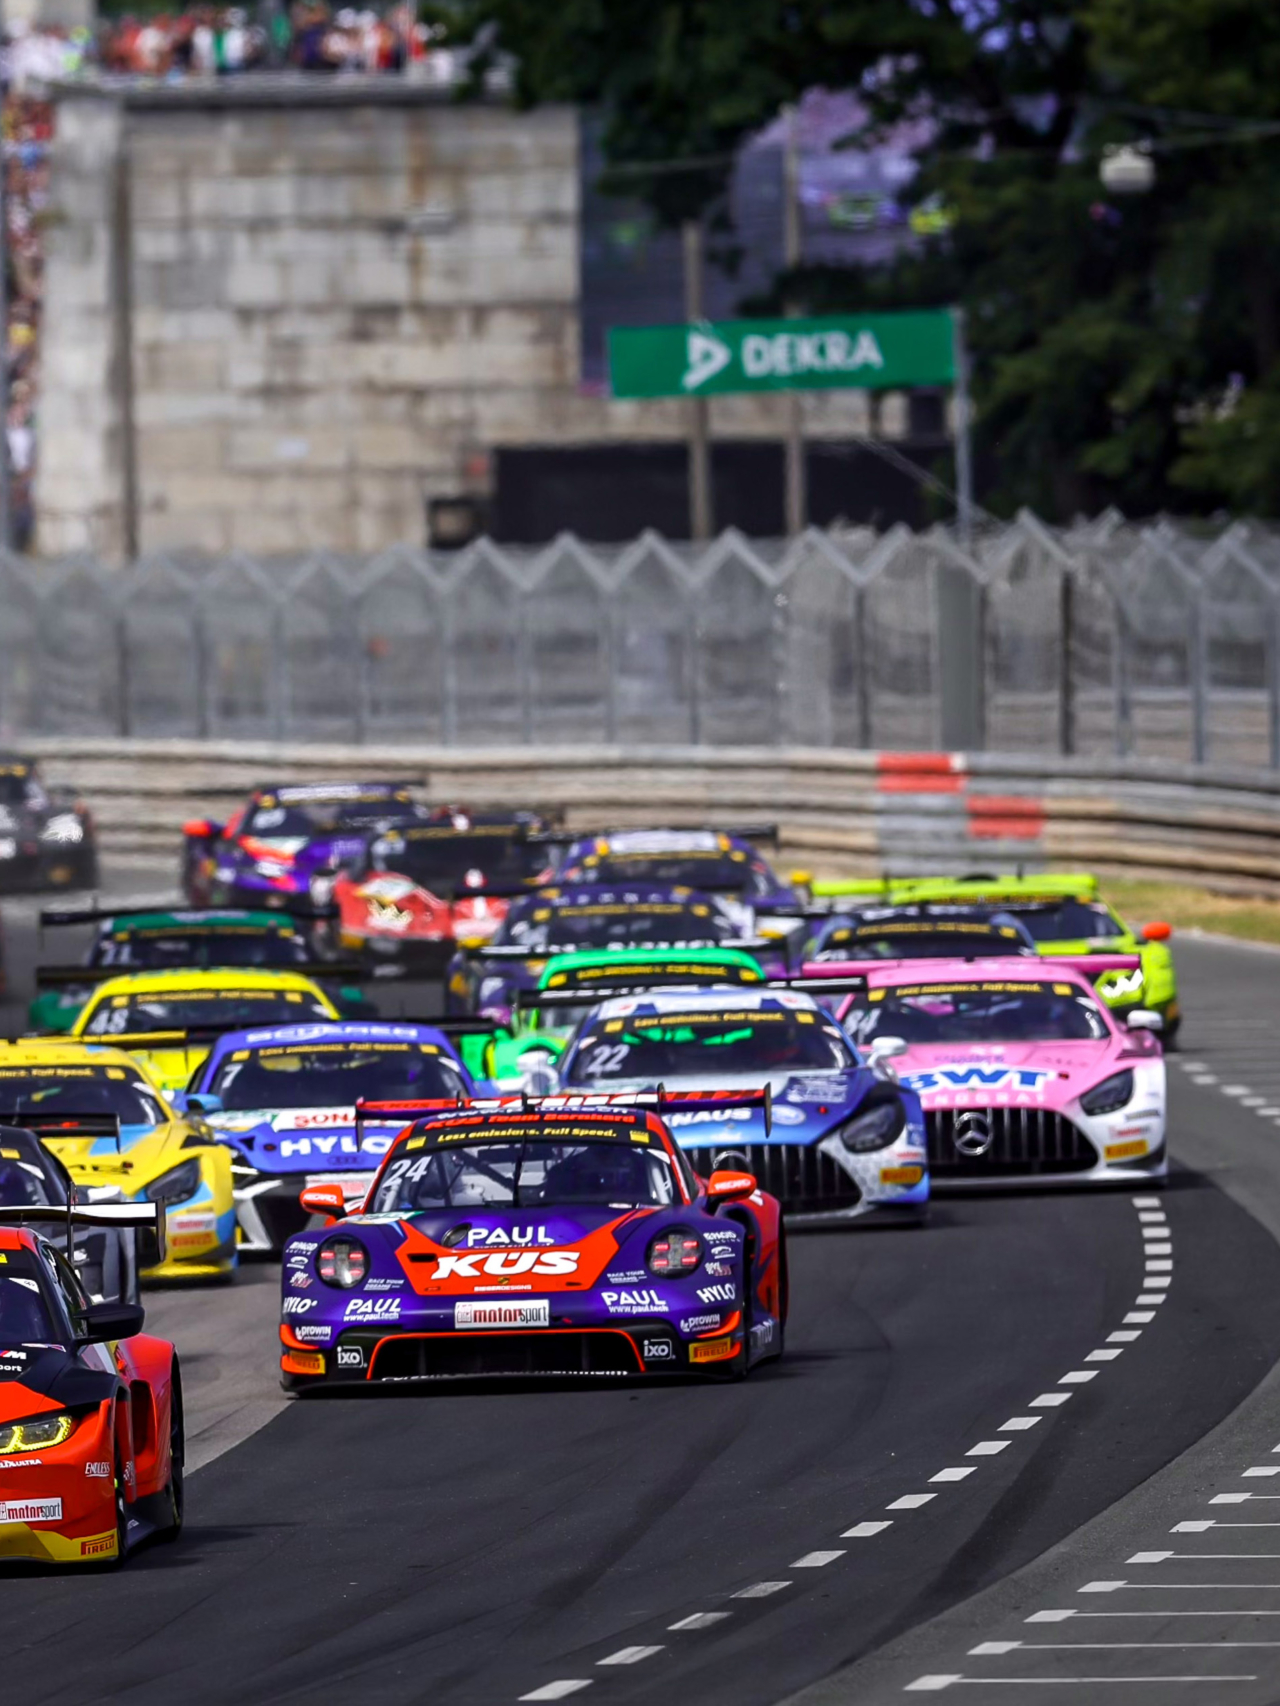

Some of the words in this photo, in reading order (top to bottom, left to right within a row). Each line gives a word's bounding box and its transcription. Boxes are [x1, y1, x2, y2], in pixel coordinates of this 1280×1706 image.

[741, 330, 885, 378] DEKRA
[587, 1044, 630, 1074] 22
[221, 1064, 243, 1088] 7
[543, 1113, 636, 1124] Bernhard
[437, 1131, 466, 1143] Less
[468, 1128, 539, 1139] emissions.
[542, 1127, 570, 1137] Full
[572, 1127, 617, 1138] Speed.
[280, 1135, 395, 1158] HYLO
[382, 1155, 433, 1188] 24
[467, 1226, 555, 1247] PAUL
[431, 1251, 580, 1279] KÜS
[601, 1289, 667, 1306] PAUL
[696, 1283, 736, 1303] HYLO
[345, 1298, 401, 1315] PAUL
[473, 1306, 547, 1324] motorsport
[609, 1303, 669, 1315] www.paul.tech
[343, 1311, 400, 1322] www.paul.tech
[337, 1346, 360, 1364] ixo
[644, 1339, 669, 1357] ixo
[85, 1461, 111, 1475] ENDLESS
[8, 1502, 61, 1519] motorsport
[81, 1534, 115, 1555] PIRELLI
